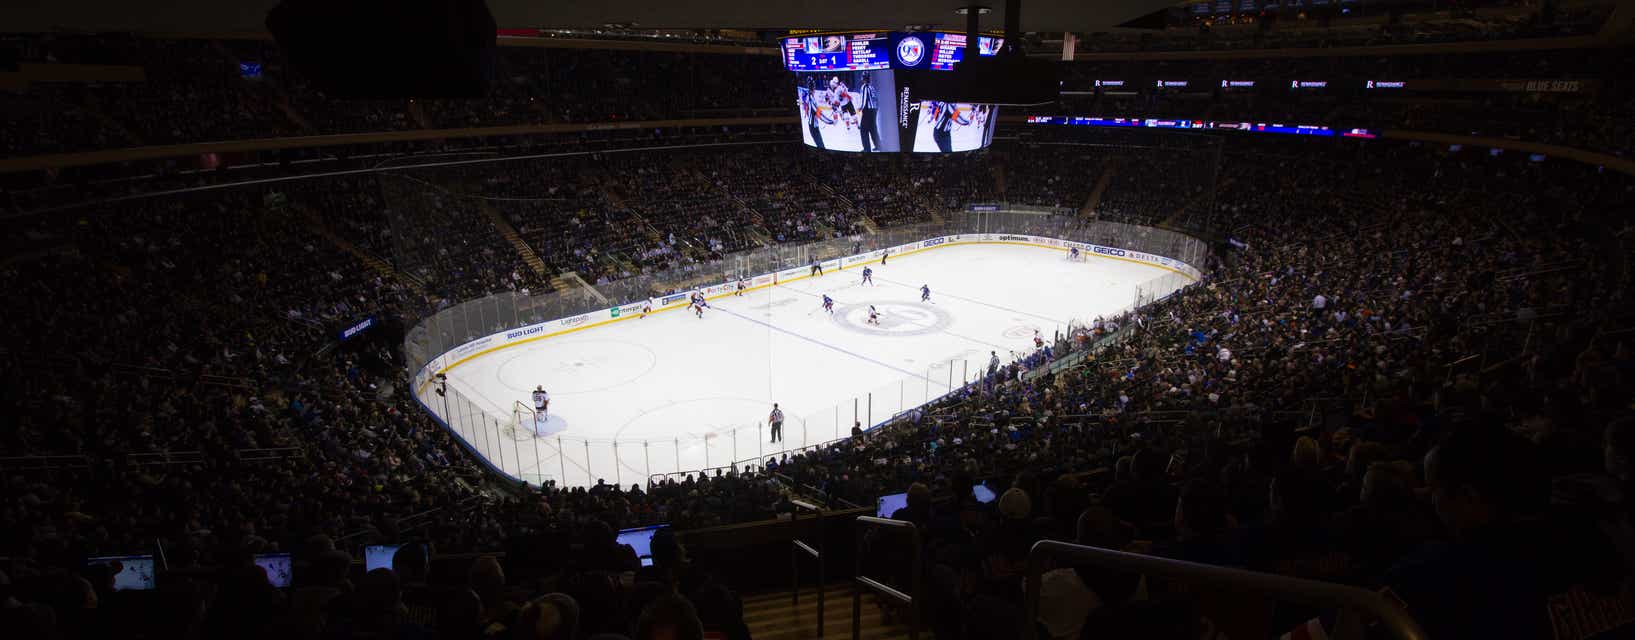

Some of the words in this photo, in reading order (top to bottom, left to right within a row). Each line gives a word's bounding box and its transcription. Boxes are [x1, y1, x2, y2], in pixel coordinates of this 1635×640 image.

[811, 57, 817, 65] 2
[831, 56, 837, 65] 1
[910, 103, 920, 113] R
[924, 238, 944, 247] GEICO
[1094, 246, 1125, 257] GEICO
[1136, 253, 1158, 262] DELTA
[507, 331, 522, 339] BUD
[523, 326, 544, 335] LIGHT
